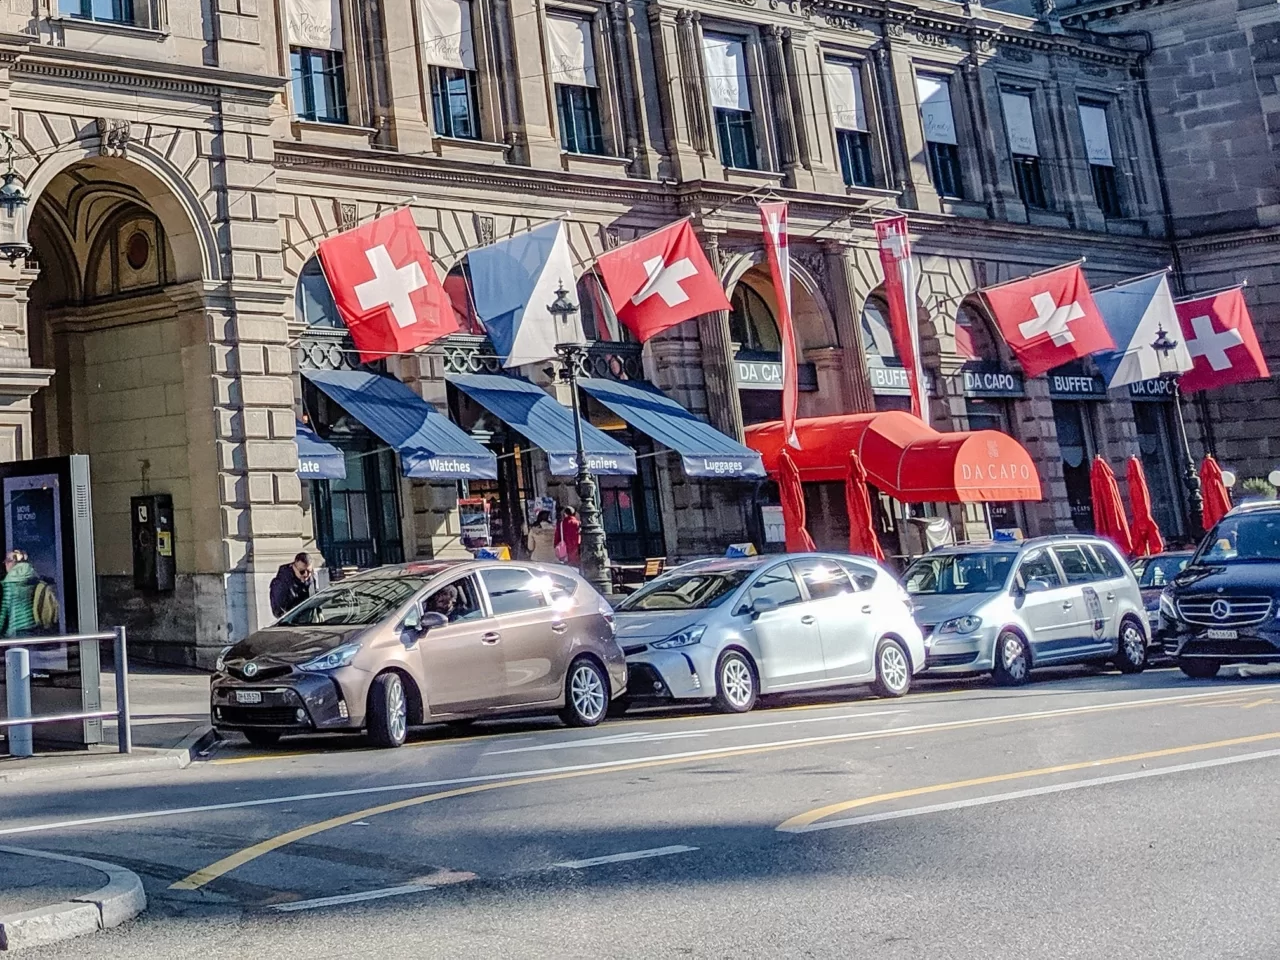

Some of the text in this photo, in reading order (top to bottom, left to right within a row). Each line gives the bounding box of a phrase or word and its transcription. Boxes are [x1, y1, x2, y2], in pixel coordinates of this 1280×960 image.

[739, 363, 782, 382] DA CA
[877, 369, 908, 386] BUFF
[966, 374, 1014, 390] DA CAPO
[1054, 376, 1094, 392] BUFFET
[1132, 382, 1147, 395] DA
[296, 459, 320, 473] late
[429, 459, 471, 473] Watches
[704, 458, 743, 474] Luggages
[961, 463, 1030, 480] DA CAPO
